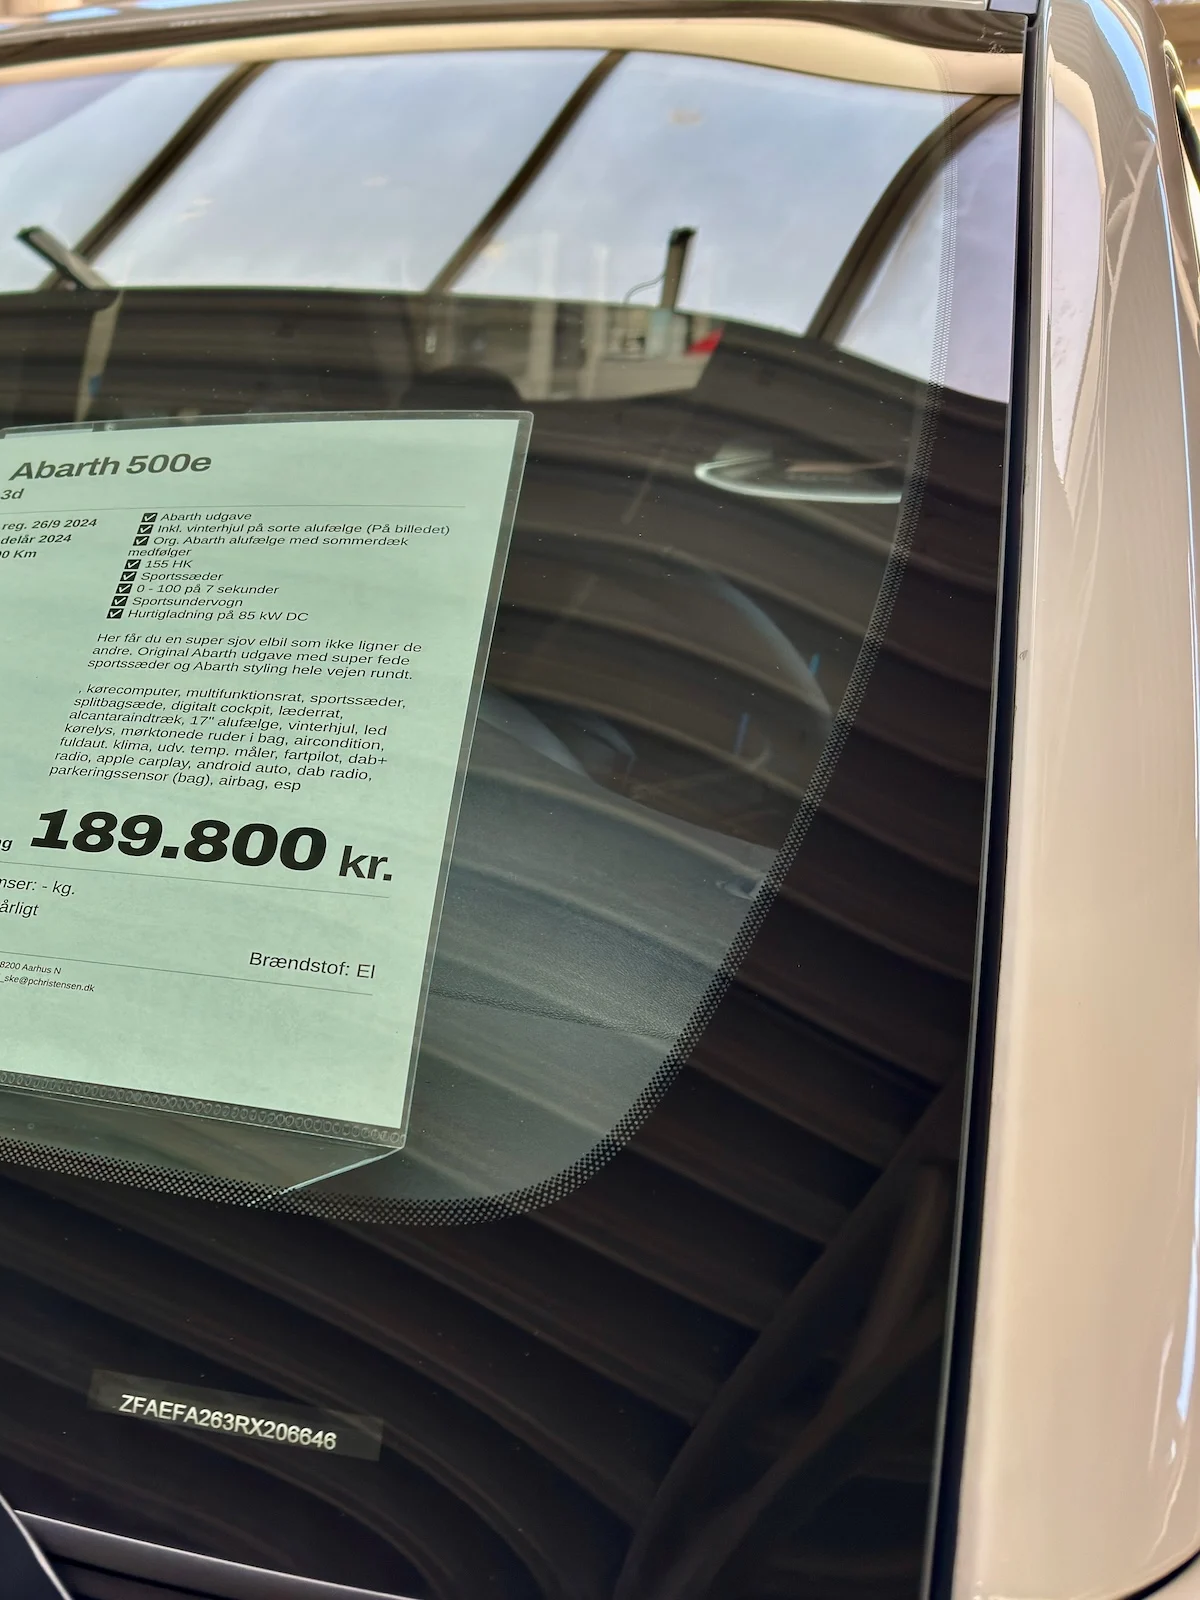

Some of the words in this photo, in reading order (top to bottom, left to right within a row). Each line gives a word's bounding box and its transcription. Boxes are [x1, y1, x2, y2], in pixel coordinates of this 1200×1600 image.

[8, 457, 120, 481] Abarth
[126, 454, 211, 474] 500e
[0, 488, 25, 500] 3d
[160, 513, 201, 521] Abarth
[206, 512, 252, 522] udgave
[2, 523, 27, 532] reg.
[32, 520, 61, 529] 26/9
[64, 519, 97, 528] 2024
[158, 525, 182, 533] Inkl.
[187, 524, 244, 534] vinterhjul
[247, 523, 263, 534] på
[304, 524, 362, 534] alufælge
[367, 524, 390, 534] (På
[395, 525, 450, 536] billedet)
[38, 534, 72, 543] 2024
[154, 537, 179, 546] Org.
[183, 536, 225, 544] Abarth
[229, 536, 285, 546] alufælge
[290, 536, 319, 544] med
[323, 537, 408, 546] sommerdæk
[13, 550, 37, 558] Km
[128, 548, 192, 558] medfølger
[145, 560, 169, 568] 155
[172, 560, 193, 568] HK
[141, 572, 223, 582] Sportssæder
[137, 585, 145, 593] 0
[157, 585, 182, 593] 100
[184, 584, 201, 595] på
[207, 585, 214, 593] 7
[217, 585, 279, 594] sekunder
[132, 597, 243, 608] Sportsundervogn
[128, 610, 214, 621] Hurtigladning
[217, 610, 234, 621] på
[239, 611, 256, 620] 85
[260, 612, 283, 620] kW
[286, 612, 309, 621] DC
[98, 634, 121, 642] Her
[124, 633, 142, 643] får
[145, 634, 162, 643] du
[186, 637, 224, 647] super
[228, 636, 256, 647] sjov
[260, 638, 287, 647] elbil
[291, 640, 321, 648] som
[326, 639, 354, 649] ikke
[359, 641, 399, 652] ligner
[404, 643, 422, 652] de
[93, 646, 132, 656] andre.
[138, 647, 189, 658] Original
[191, 649, 237, 658] Abarth
[241, 650, 292, 661] udgave
[297, 653, 328, 662] med
[332, 655, 373, 665] super
[378, 655, 410, 665] fede
[88, 660, 170, 669] sportssæder
[174, 663, 190, 672] og
[193, 662, 239, 672] Abarth
[243, 664, 288, 676] styling
[292, 665, 322, 675] hele
[328, 667, 366, 679] vejen
[371, 670, 412, 680] rundt.
[87, 684, 181, 698] kørecomputer,
[186, 689, 304, 703] multifunktionsrat,
[310, 696, 405, 709] sportssæder,
[74, 697, 166, 711] splitbagsæde,
[172, 701, 217, 713] digitalt
[221, 704, 273, 716] cockpit,
[279, 706, 343, 720] læderrat,
[69, 710, 184, 726] alcantaraindtræk,
[218, 717, 282, 731] alufælge,
[289, 721, 358, 735] vinterhjul,
[364, 725, 387, 736] led
[65, 723, 115, 736] kørelys,
[121, 728, 203, 739] mørktonede
[208, 732, 246, 742] ruder
[250, 732, 254, 742] i
[258, 733, 288, 746] bag,
[294, 736, 384, 752] aircondition,
[60, 737, 107, 749] fuldaut.
[113, 740, 152, 753] klima,
[158, 743, 185, 753] udv.
[191, 745, 229, 758] temp.
[235, 746, 278, 760] måler,
[284, 749, 342, 764] fartpilot,
[349, 754, 387, 765] dab+
[55, 752, 91, 763] radio,
[97, 754, 134, 766] apple
[139, 757, 191, 770] carplay,
[197, 760, 252, 772] android
[256, 765, 291, 776] auto,
[297, 766, 325, 777] dab
[330, 769, 371, 782] radio,
[49, 766, 169, 781] parkeringssensor
[173, 772, 213, 787] (bag),
[219, 776, 268, 790] airbag,
[274, 781, 301, 793] esp
[30, 809, 327, 871] 189.800
[338, 845, 393, 881] kr.
[52, 881, 74, 897] kg.
[0, 961, 21, 970] 8200
[22, 964, 52, 973] Aarhus
[250, 952, 350, 976] Brændstof:
[357, 964, 375, 979] El
[119, 1394, 337, 1450] ZFAEFA263RX206646
